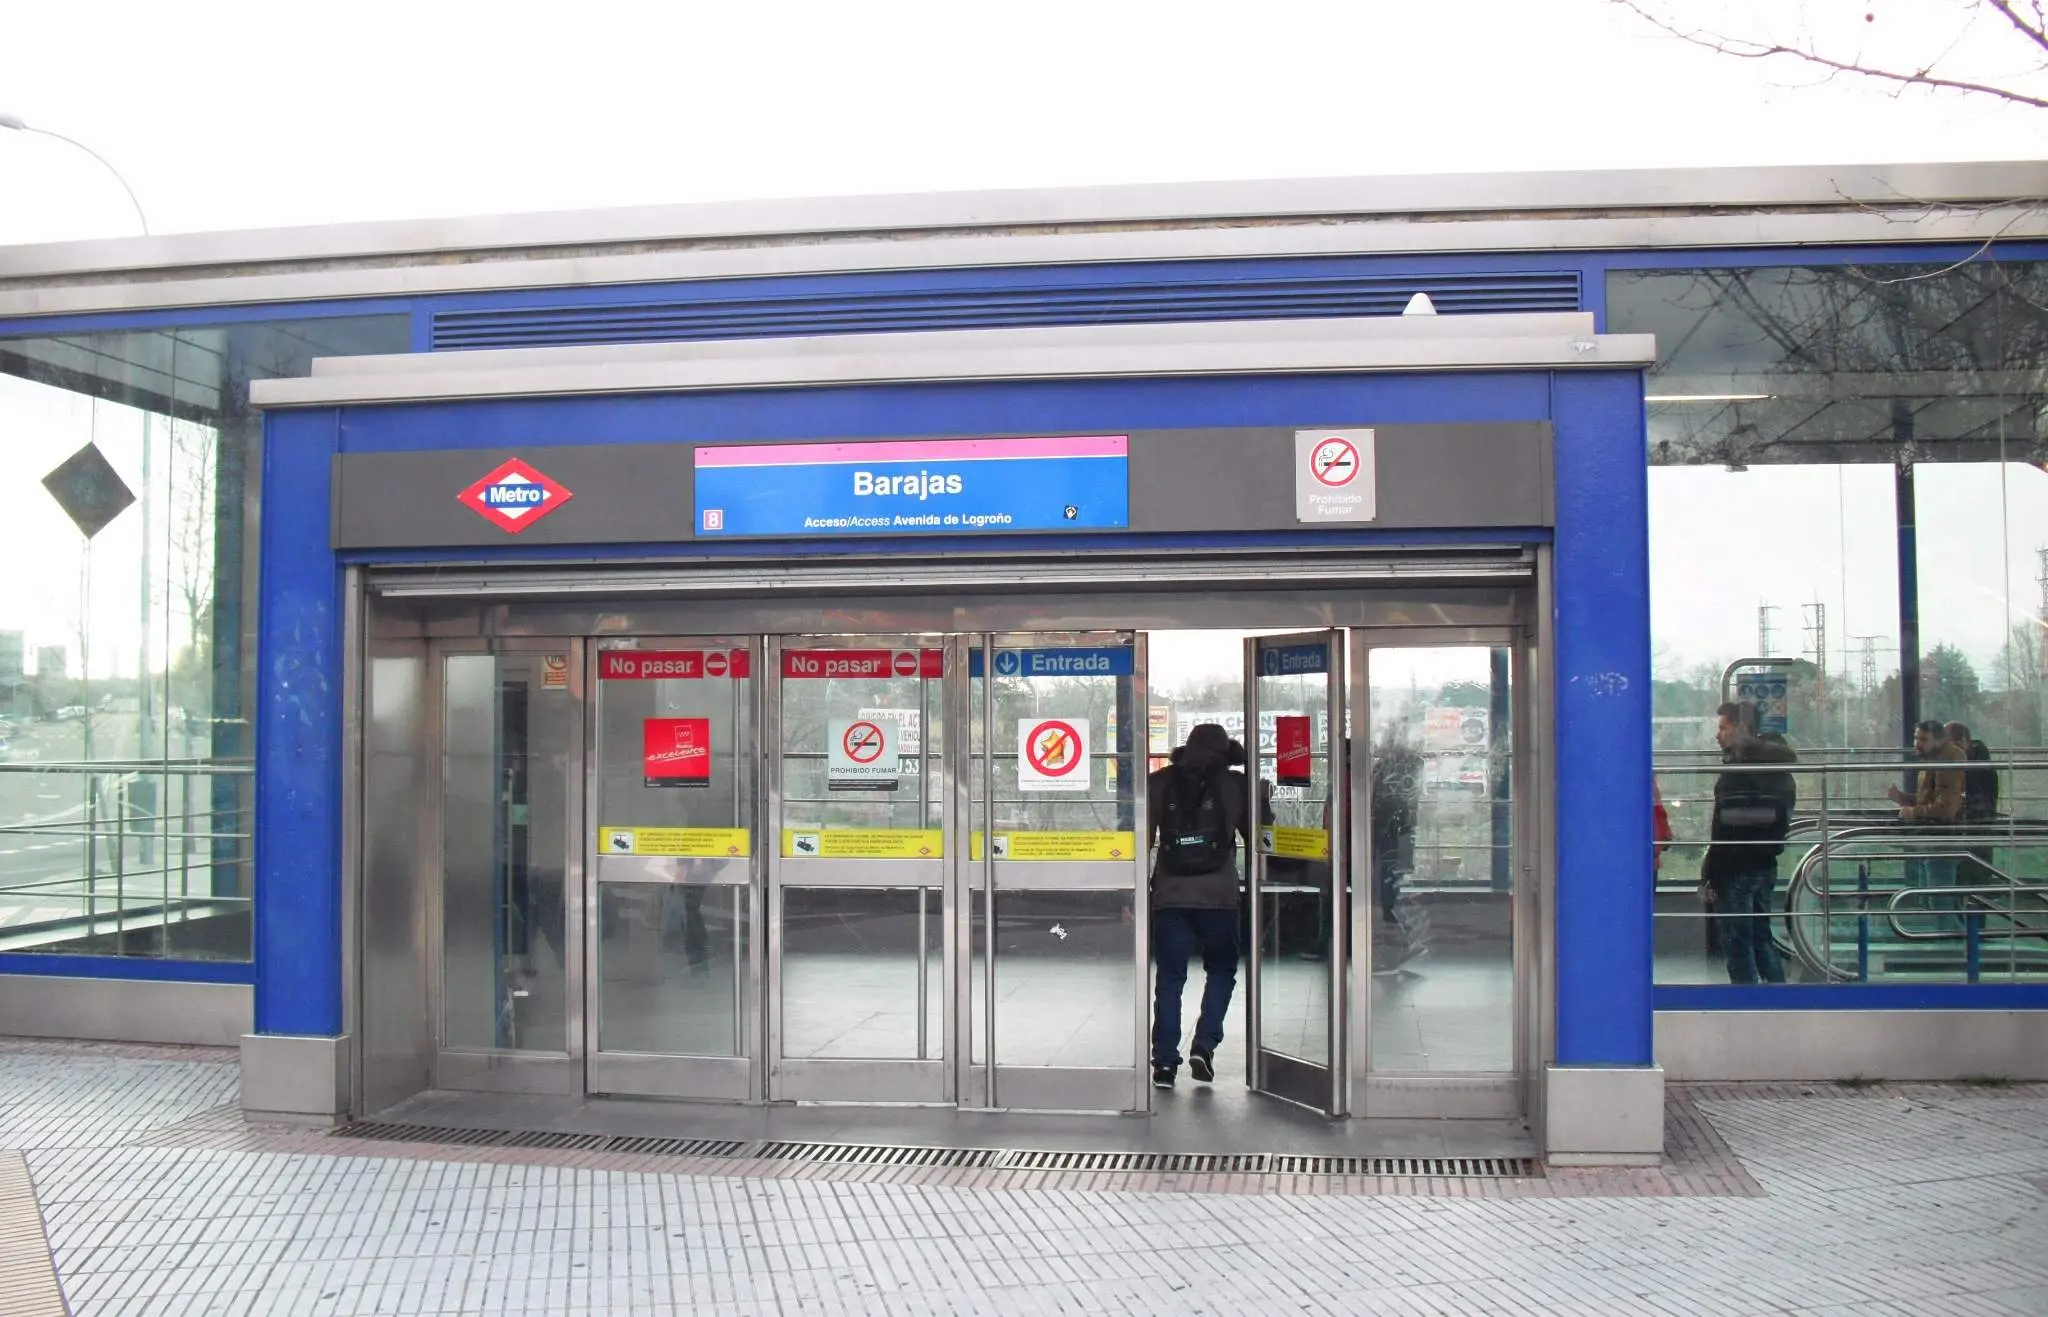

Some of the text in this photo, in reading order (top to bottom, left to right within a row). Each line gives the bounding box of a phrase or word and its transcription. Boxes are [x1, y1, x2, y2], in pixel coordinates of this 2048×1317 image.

[853, 470, 963, 501] Barajas
[490, 486, 540, 503] Metro
[1308, 494, 1362, 504] Prohibido
[1318, 505, 1353, 514] Fumar
[708, 512, 719, 528] 8
[804, 512, 1012, 528] Acceso/Access Avenida de Logroño
[609, 657, 693, 678] No pasar
[791, 656, 880, 677] No pasar
[1031, 653, 1110, 671] Entrada
[1282, 651, 1322, 670] Entrada
